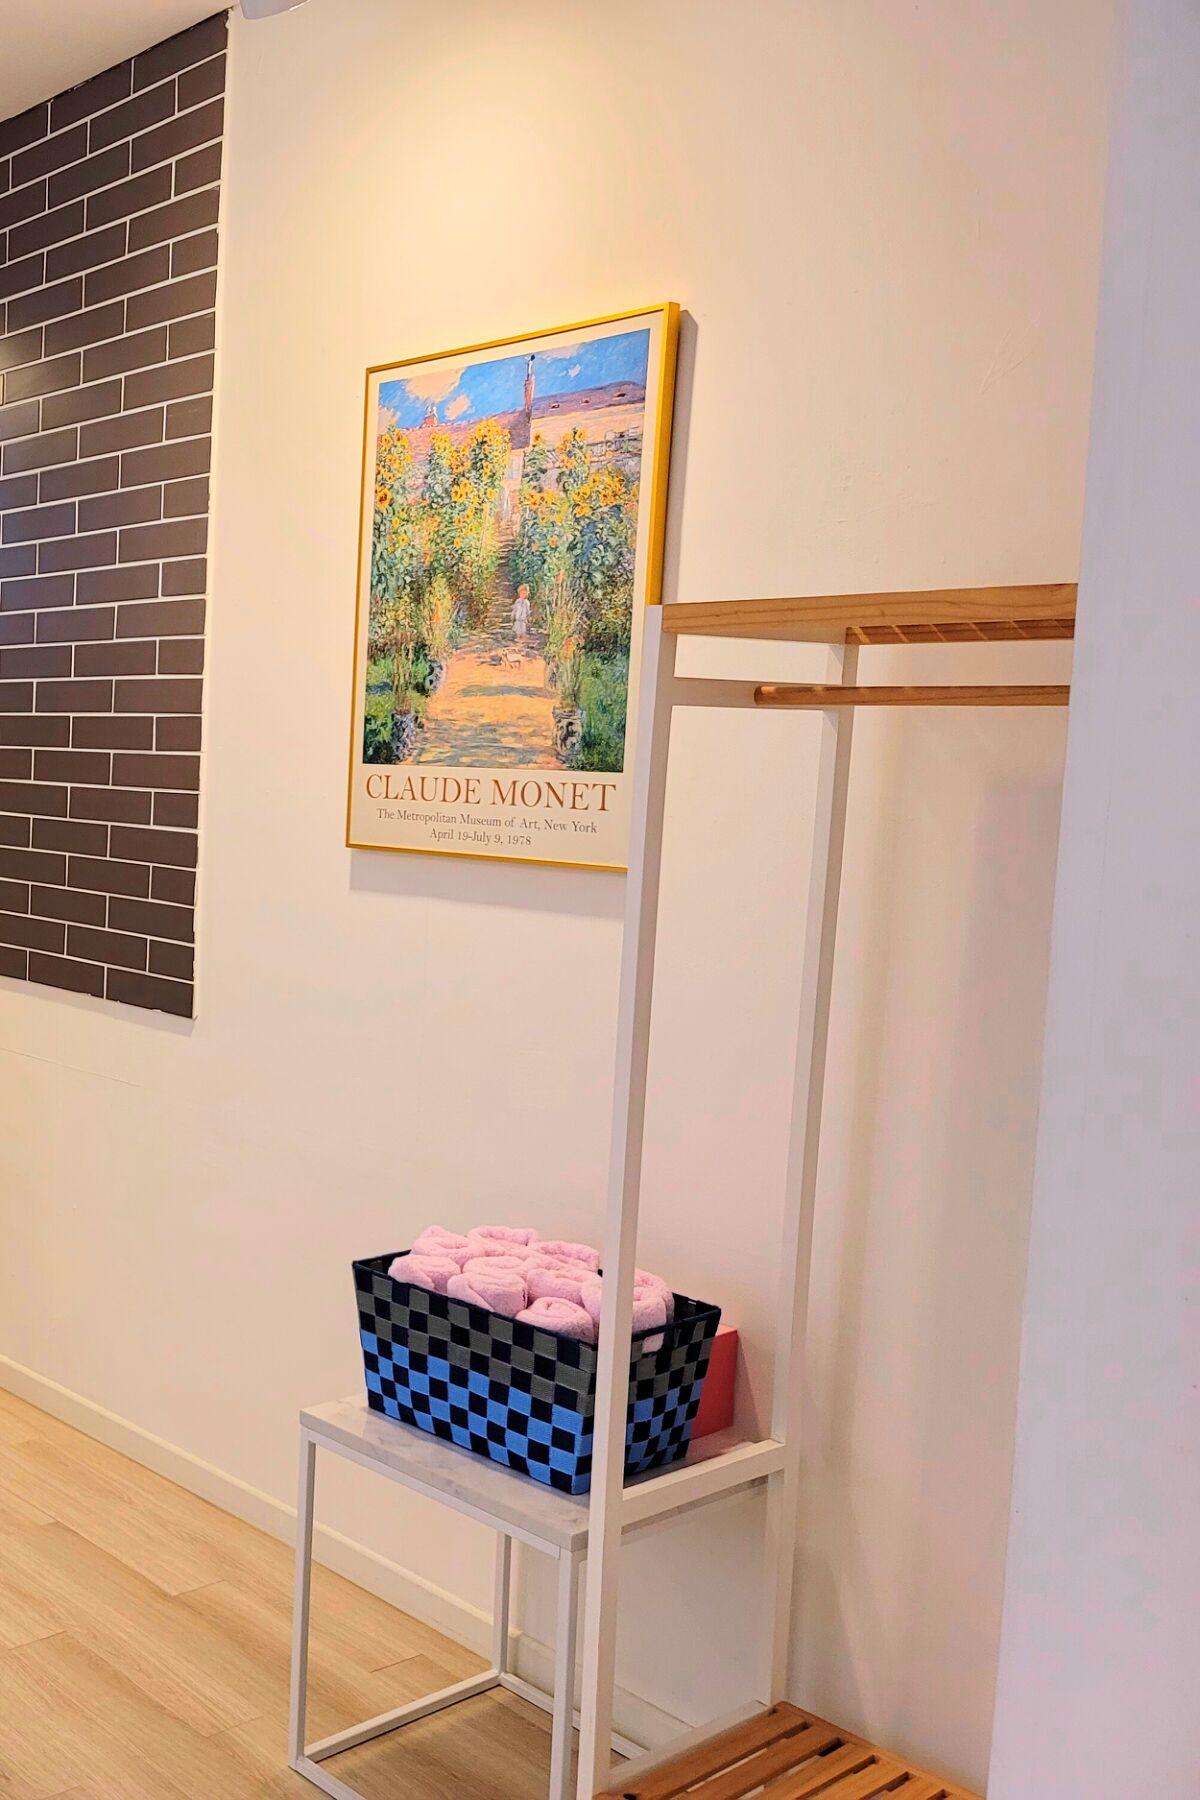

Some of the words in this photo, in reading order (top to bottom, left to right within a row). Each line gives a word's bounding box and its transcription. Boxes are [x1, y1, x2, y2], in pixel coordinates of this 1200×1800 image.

[366, 774, 481, 805] CLAUDE
[490, 779, 617, 812] MONET
[376, 808, 395, 819] The
[397, 809, 457, 825] Metropolitan
[460, 813, 502, 827] Museum
[504, 816, 516, 828] of
[519, 817, 541, 831] Art,
[543, 818, 568, 831] New
[571, 820, 598, 834] York
[430, 828, 454, 842] April
[457, 830, 493, 846] 19-July
[494, 833, 504, 845] 9,
[507, 833, 532, 846] 1978
